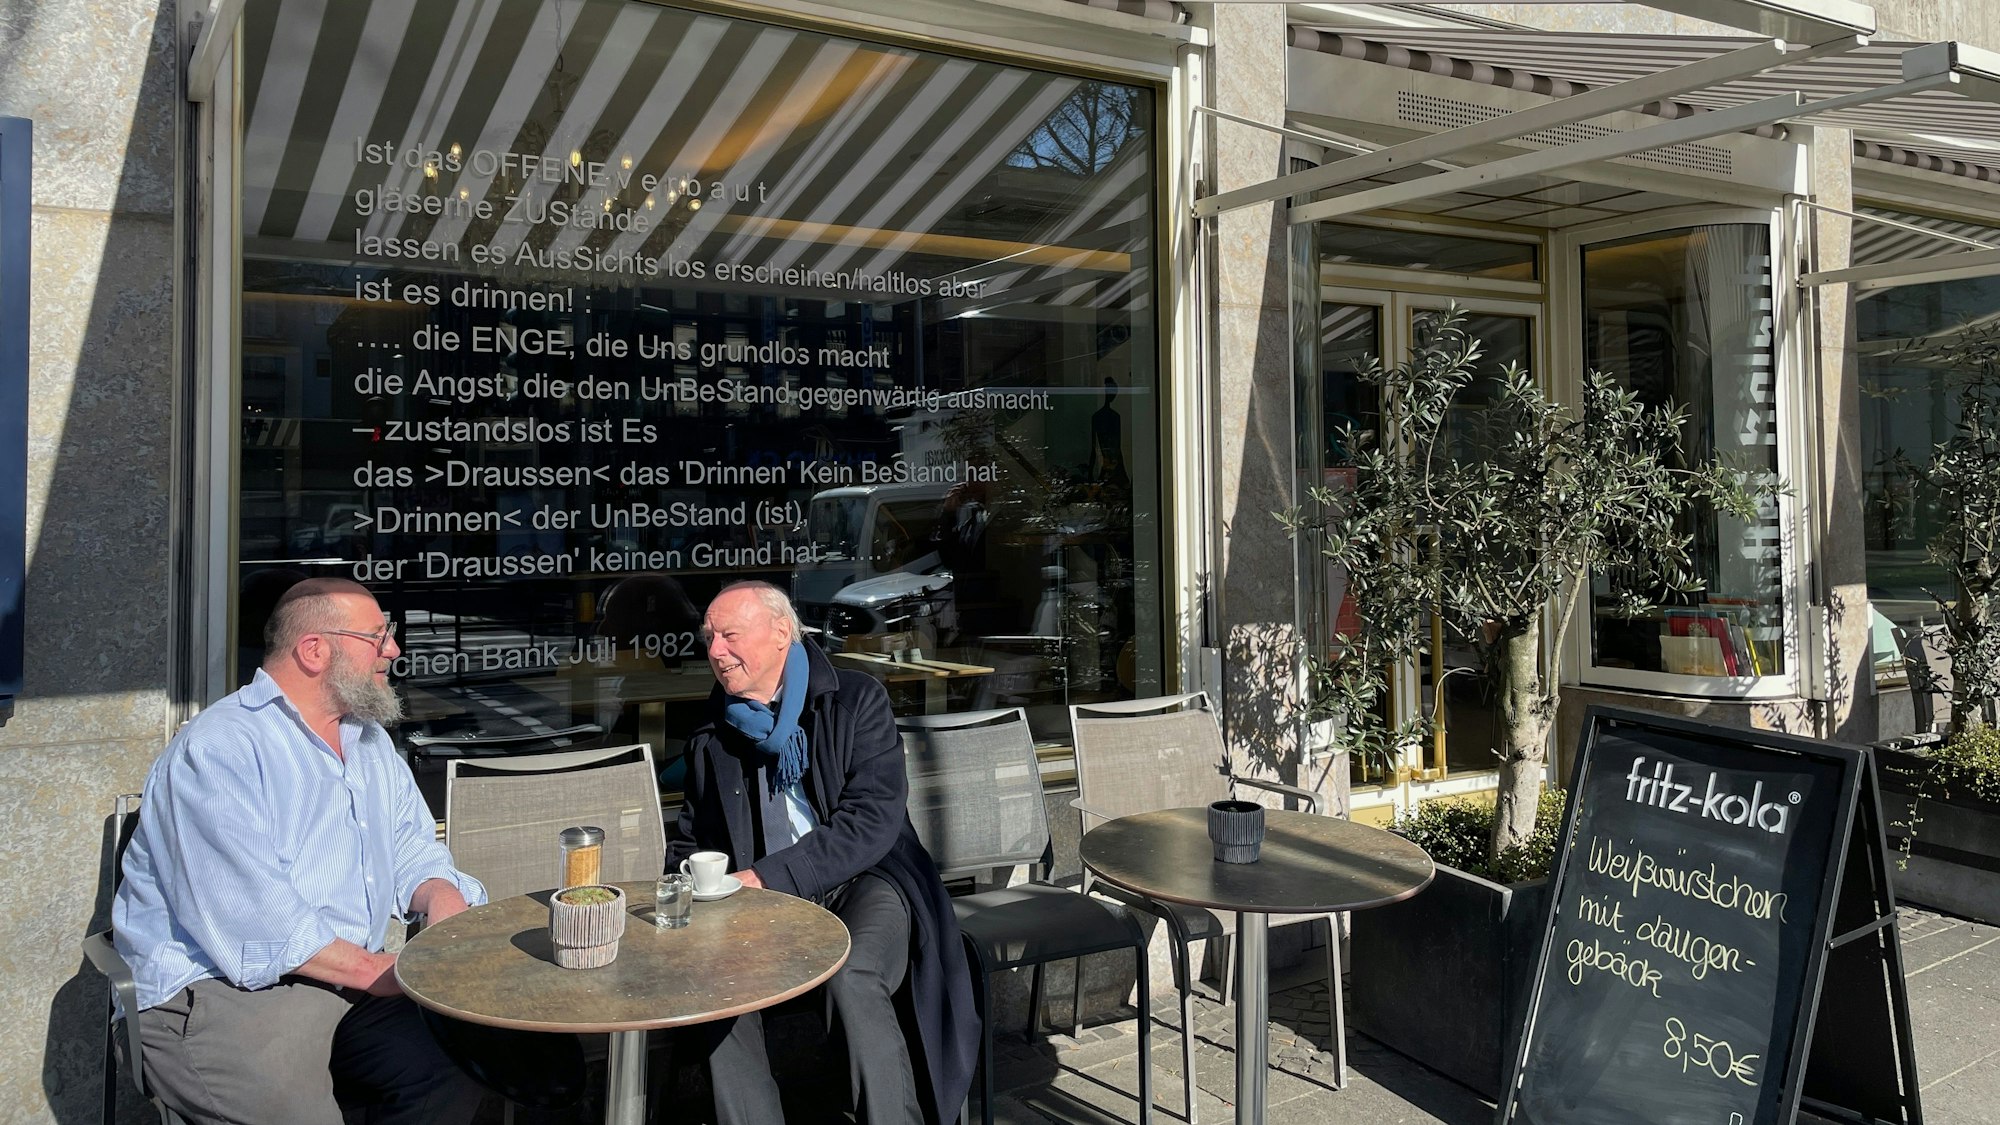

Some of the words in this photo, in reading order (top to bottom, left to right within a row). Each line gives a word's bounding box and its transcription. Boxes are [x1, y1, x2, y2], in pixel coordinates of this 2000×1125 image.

[357, 136, 394, 166] Ist
[405, 143, 462, 172] das
[473, 149, 607, 187] OFFENE
[355, 184, 493, 220] gläserne
[504, 197, 650, 233] ZUStände
[355, 229, 459, 262] lassen
[471, 243, 507, 265] es
[515, 242, 659, 275] AusSichts
[669, 253, 706, 280] los
[714, 261, 932, 296] erscheinen/haltlos
[939, 276, 987, 300] aber
[355, 275, 393, 302] ist
[402, 283, 441, 306] es
[451, 282, 573, 313] drinnen!
[412, 324, 460, 351] die
[472, 326, 575, 360] ENGE,
[586, 332, 629, 358] die
[638, 334, 692, 361] Uns
[701, 340, 810, 368] grundlos
[818, 346, 890, 369] macht
[354, 368, 404, 396] die
[412, 369, 512, 404] Angst,
[523, 373, 567, 399] die
[577, 375, 630, 401] den
[641, 376, 790, 404] UnBeStand
[799, 386, 940, 413] gegenwärtig
[948, 389, 1055, 412] ausmacht.
[385, 416, 571, 443] zustandslos
[581, 417, 613, 442] ist
[622, 418, 658, 444] Es
[354, 460, 413, 488] das
[424, 459, 610, 488] >Draussen<
[620, 461, 670, 486] das
[679, 459, 791, 485] 'Drinnen'
[801, 460, 853, 485] Kein
[862, 460, 957, 483] BeStand
[965, 460, 999, 482] hat
[354, 506, 522, 534] >Drinnen<
[532, 504, 581, 531] der
[591, 501, 746, 529] UnBeStand
[756, 500, 808, 531] (ist),
[353, 553, 408, 581] der
[418, 546, 580, 579] 'Draussen'
[591, 546, 680, 572] keinen
[691, 541, 772, 568] Grund
[781, 540, 819, 564] hat
[386, 651, 470, 678] chen
[482, 640, 559, 671] Bank
[569, 636, 617, 665] Juli
[629, 632, 695, 660] 1982
[1578, 894, 1625, 933] mit
[1663, 1017, 1760, 1087] 8,50€
